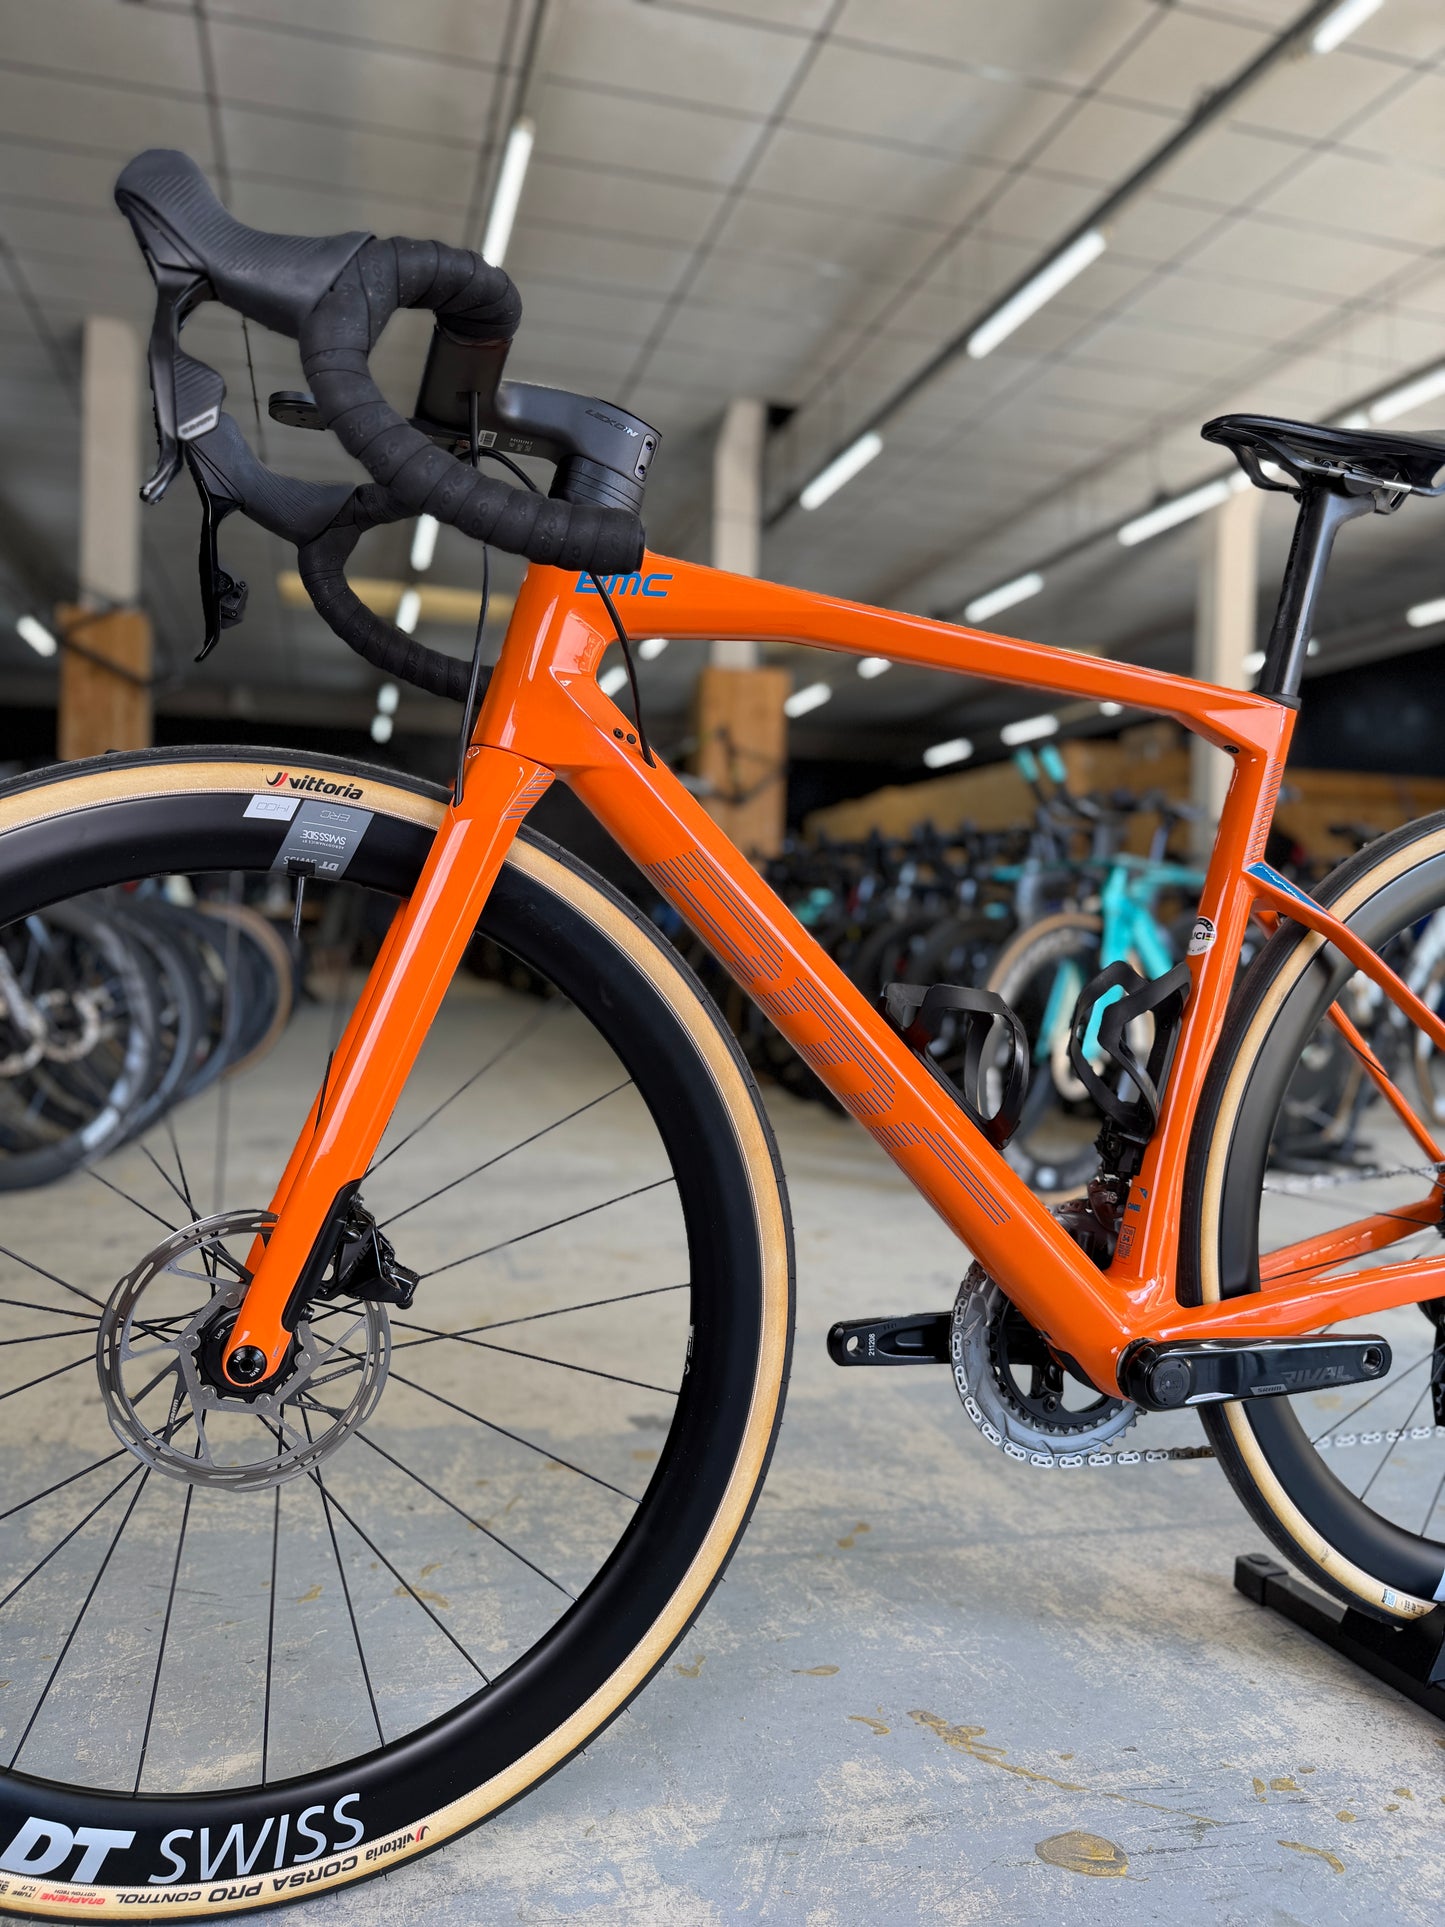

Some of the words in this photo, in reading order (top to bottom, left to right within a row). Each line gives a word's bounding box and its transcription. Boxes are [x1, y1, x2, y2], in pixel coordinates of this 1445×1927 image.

[574, 569, 674, 598] BMC
[289, 775, 364, 800] vittoria
[319, 809, 351, 823] ERC
[318, 861, 340, 872] DT
[868, 1333, 876, 1356] 211208
[1280, 1365, 1356, 1384] RIVAL
[0, 1815, 137, 1884] DT
[148, 1792, 365, 1884] SWISS
[365, 1831, 416, 1861] vittoria
[272, 1855, 359, 1892] CORSA
[11, 1890, 33, 1898] TUBE
[40, 1892, 106, 1905] GRAPHENE
[116, 1891, 202, 1904] CONTROL
[207, 1880, 263, 1903] PRO
